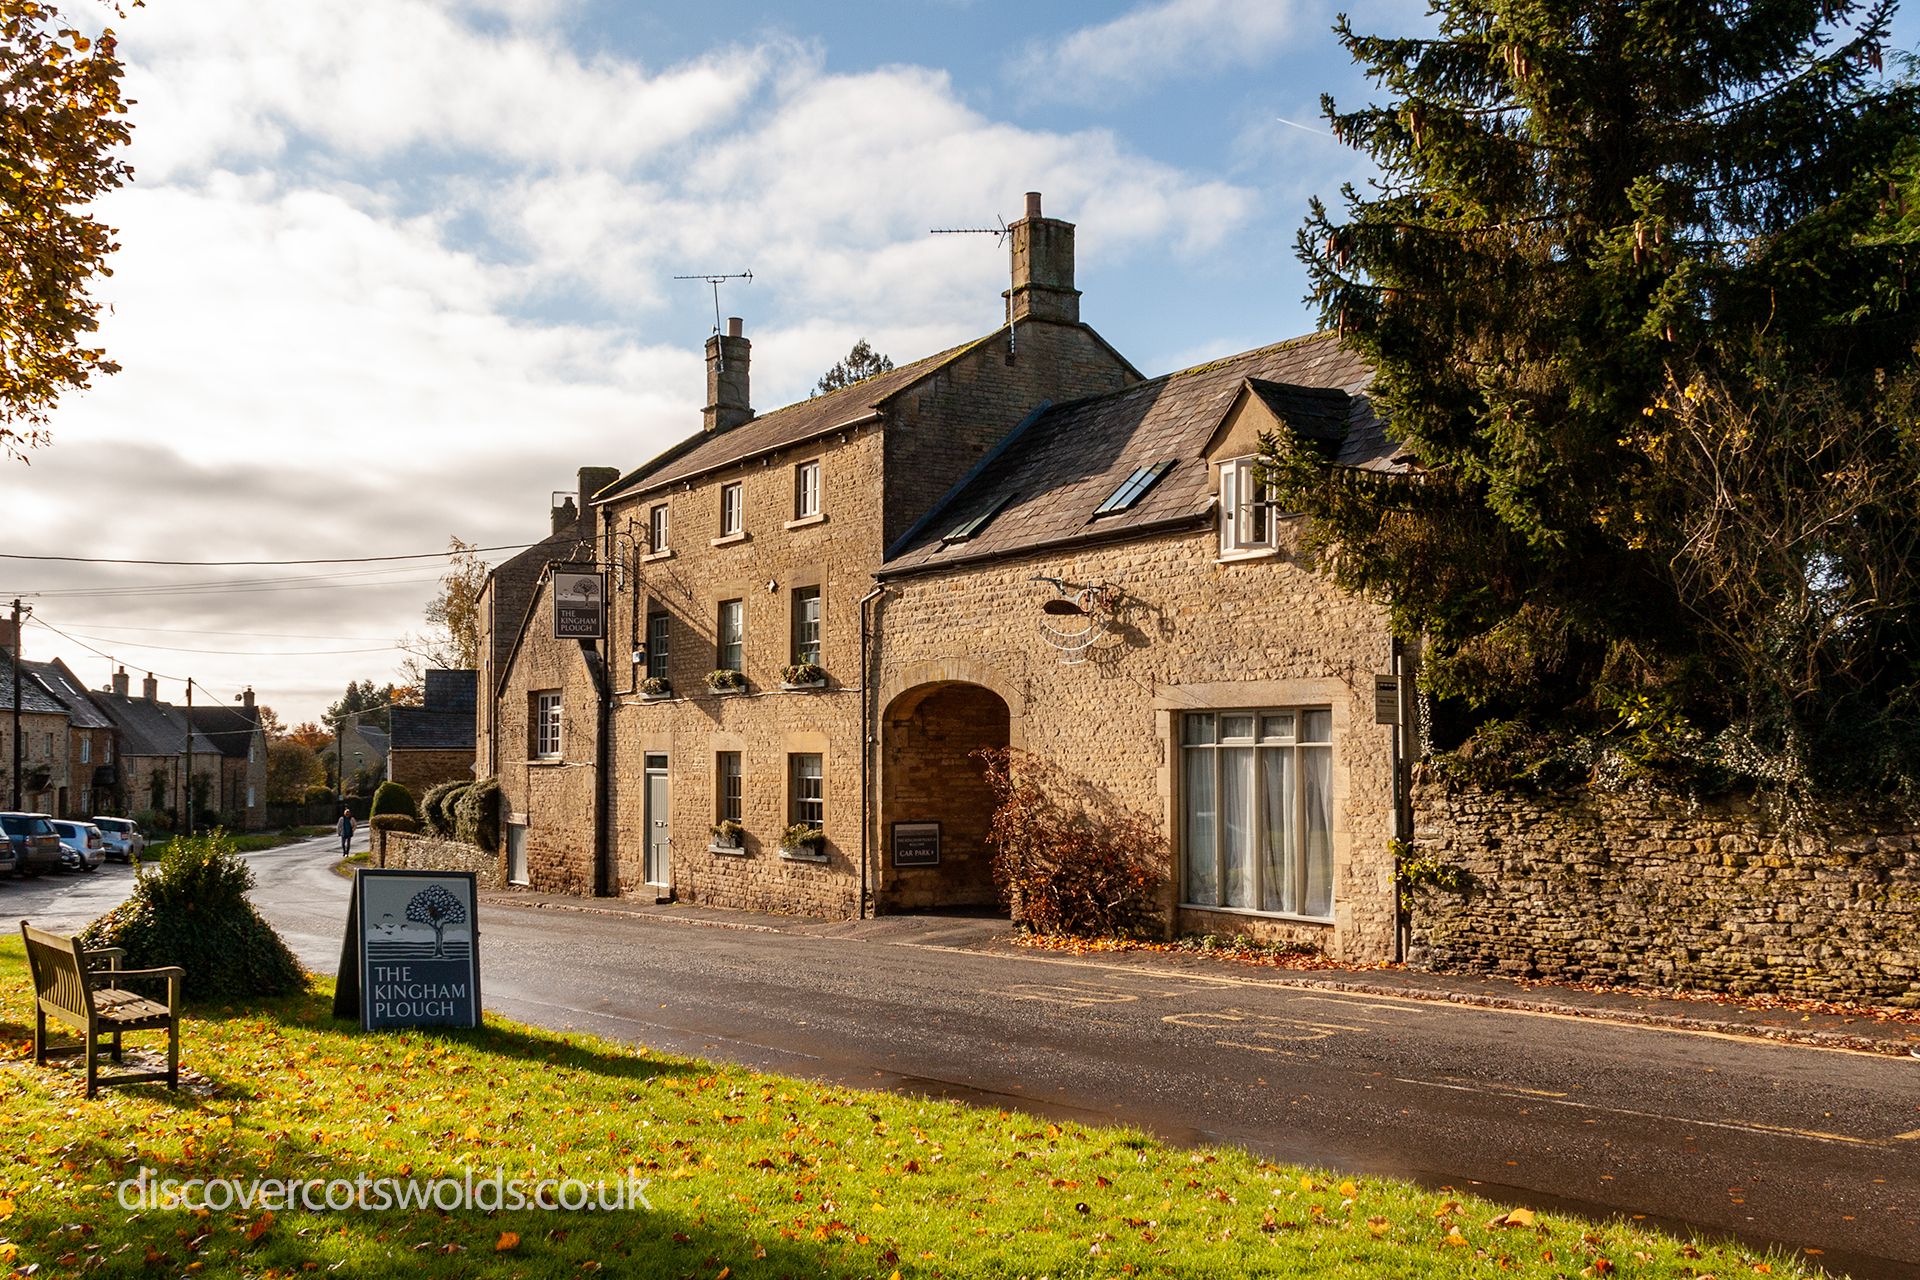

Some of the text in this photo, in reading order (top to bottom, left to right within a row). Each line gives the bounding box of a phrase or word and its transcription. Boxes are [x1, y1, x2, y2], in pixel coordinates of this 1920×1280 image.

[560, 617, 597, 625] KINGHAM
[560, 624, 593, 632] PLOUGH
[374, 966, 412, 982] THE
[375, 983, 466, 1000] KINGHAM
[375, 1001, 455, 1018] PLOUGH
